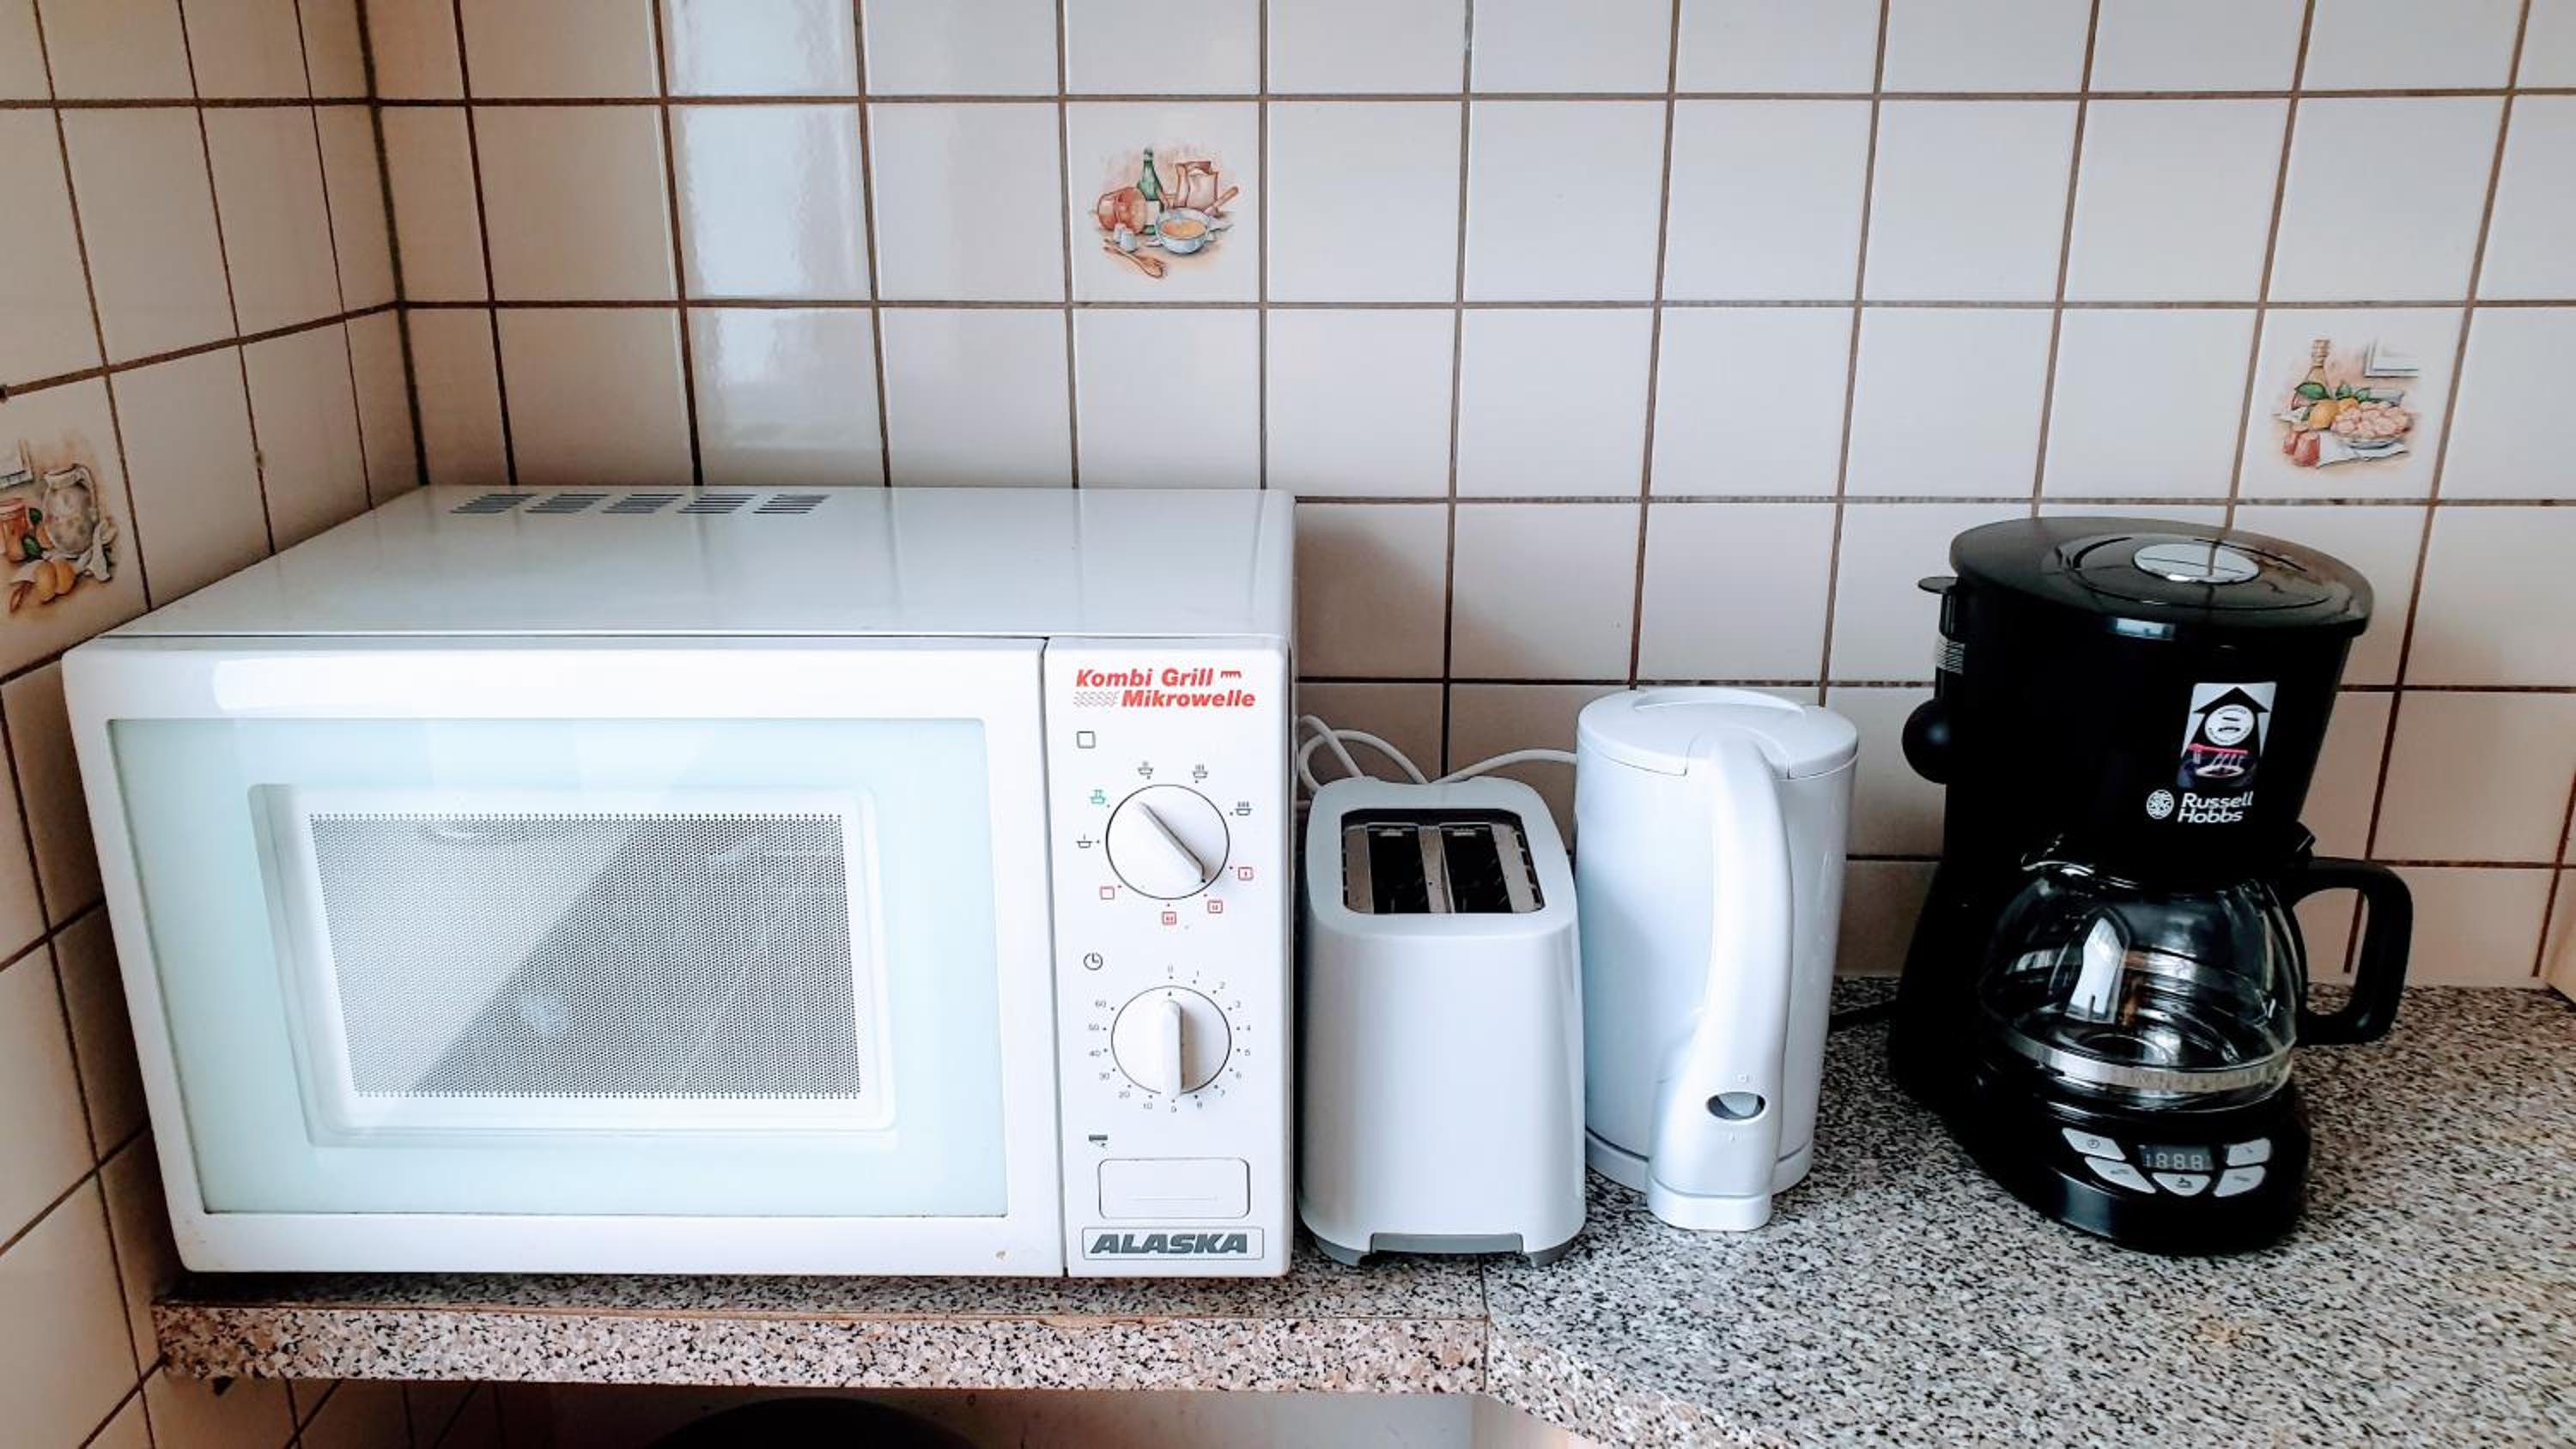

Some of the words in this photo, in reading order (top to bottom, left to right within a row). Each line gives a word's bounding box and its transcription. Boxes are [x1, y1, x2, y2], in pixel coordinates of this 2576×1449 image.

[1076, 669, 1153, 687] Kombi
[1162, 668, 1214, 687] Grill
[1121, 689, 1256, 707] Mikrowelle
[2181, 791, 2254, 809] Russell
[2177, 808, 2244, 823] Hobbs
[1090, 1234, 1248, 1254] ALASKA
